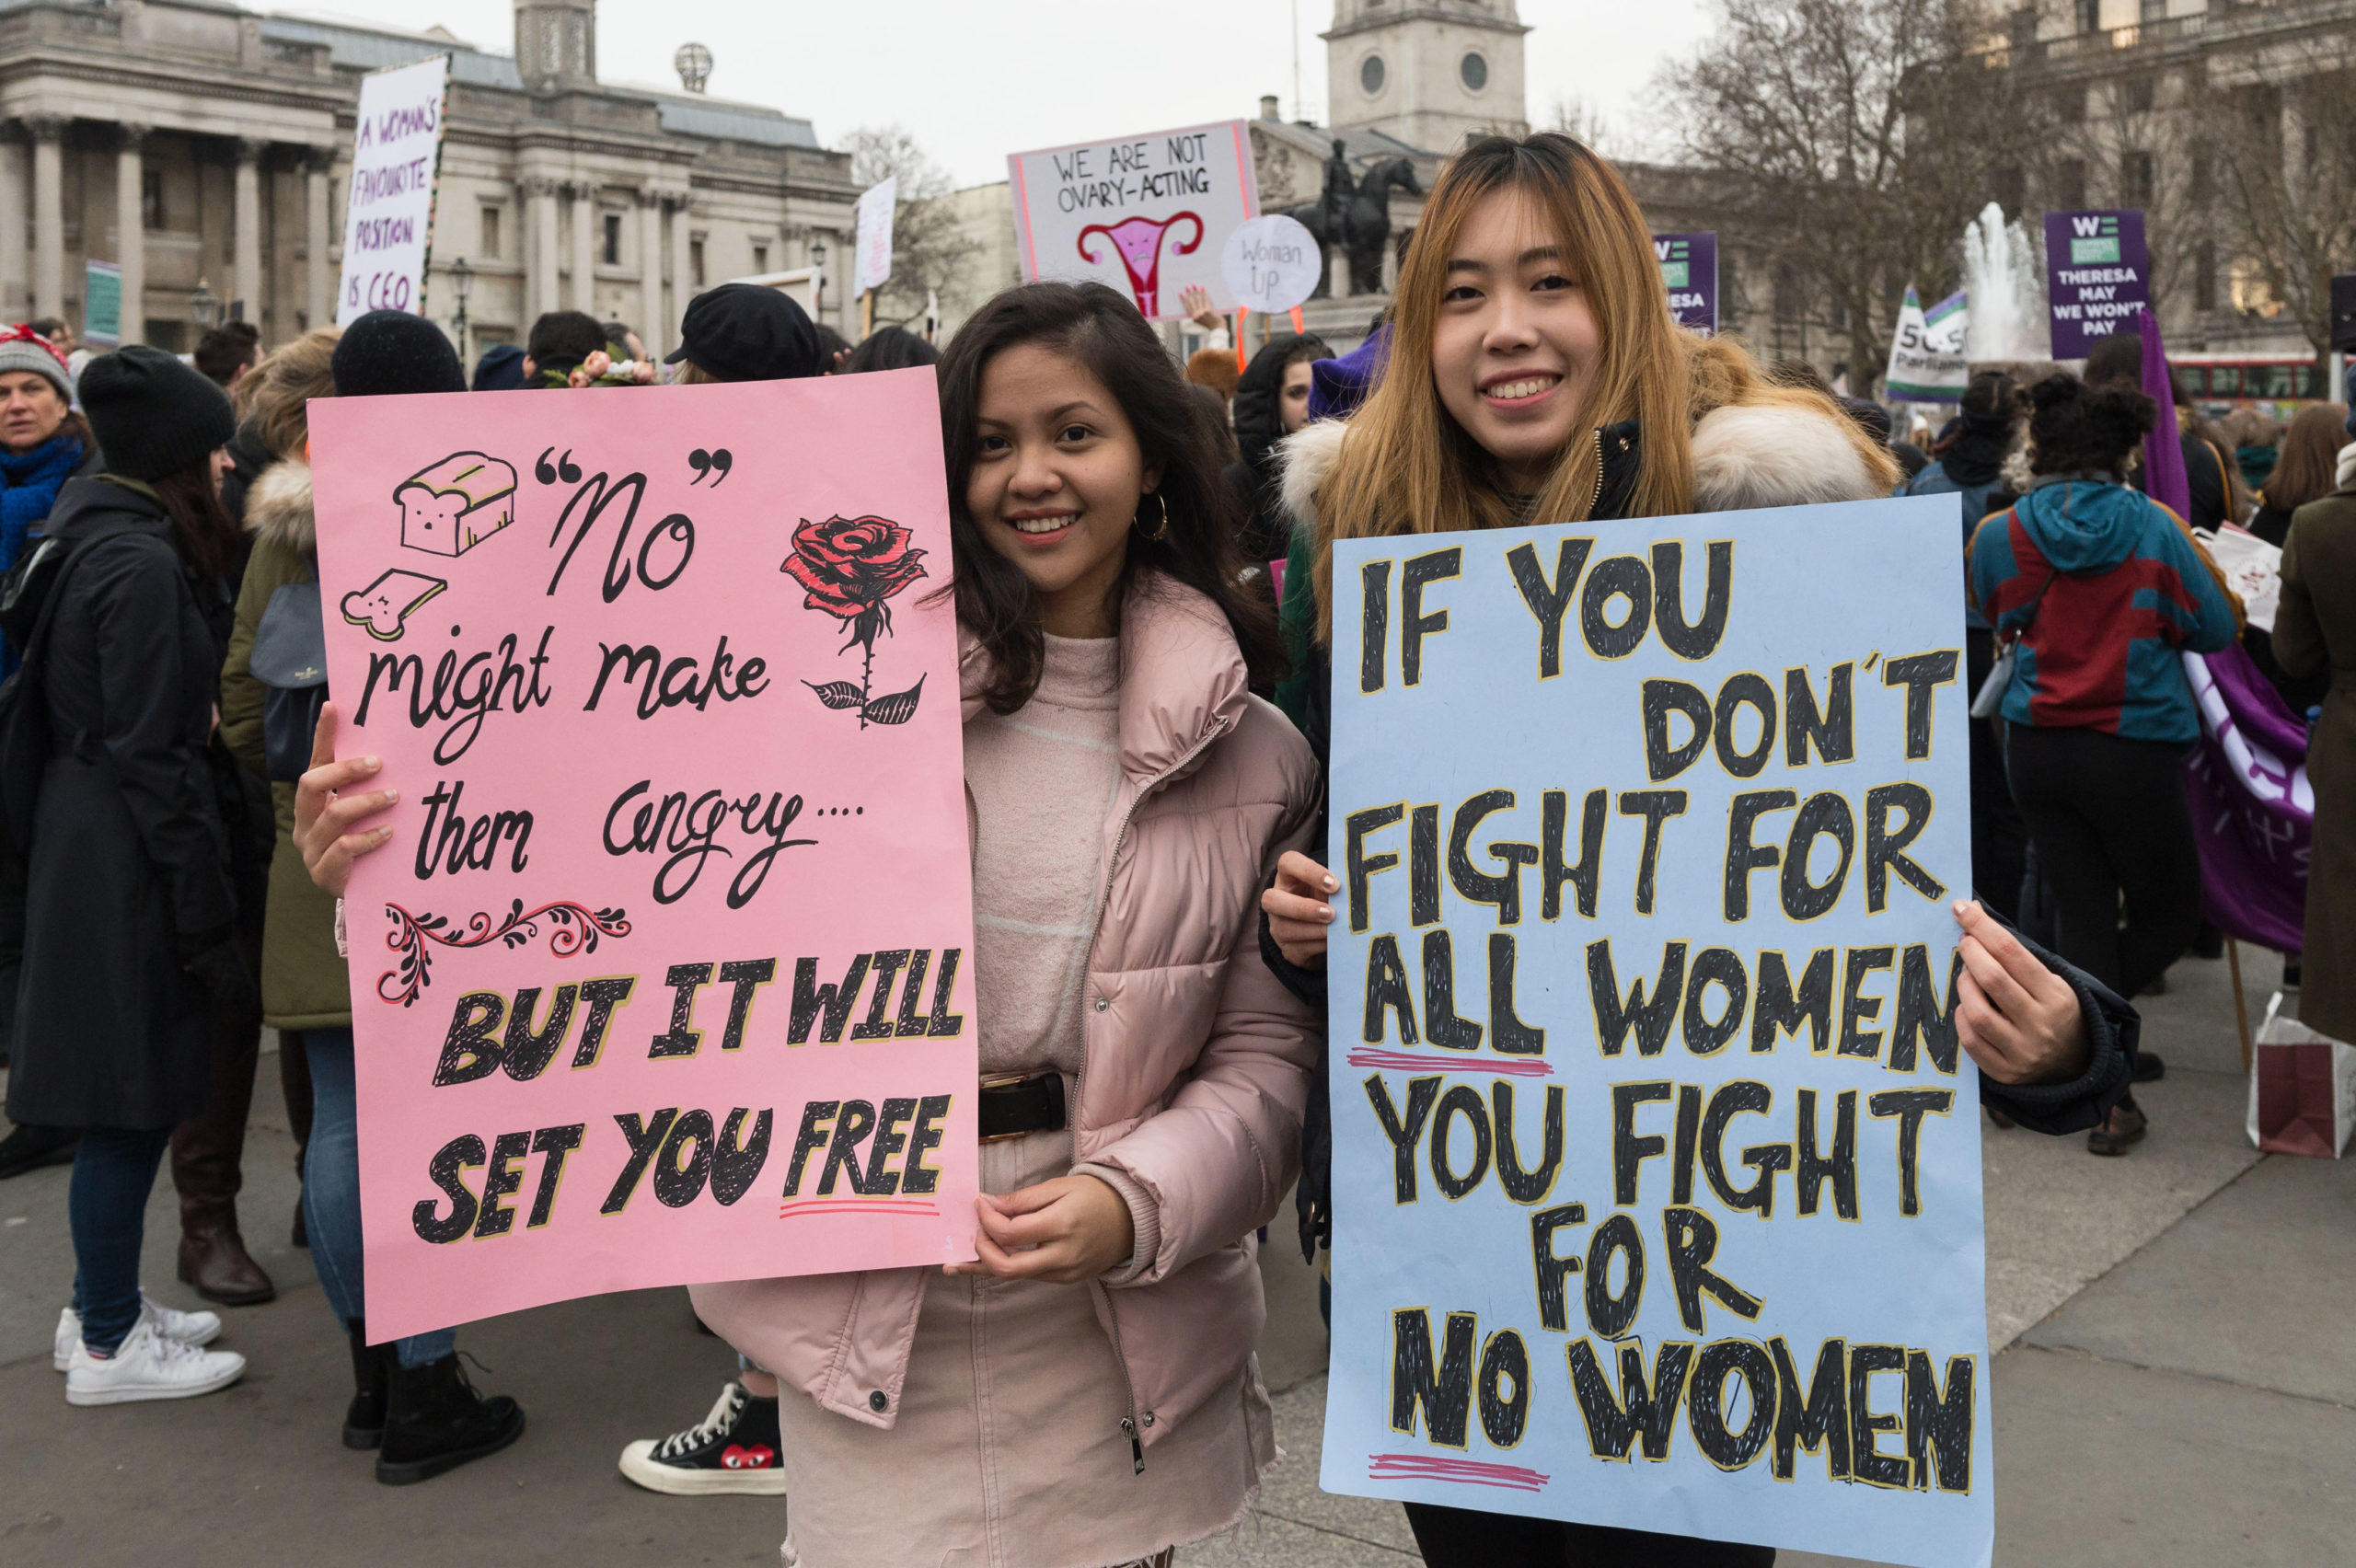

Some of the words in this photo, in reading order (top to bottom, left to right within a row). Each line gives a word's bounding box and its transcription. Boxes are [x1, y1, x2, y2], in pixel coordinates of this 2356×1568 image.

[359, 117, 372, 149] A
[379, 97, 437, 144] WOMAN'S
[1053, 148, 1093, 181] WE
[1109, 142, 1149, 174] ARE
[1168, 133, 1207, 165] NOT
[353, 156, 427, 206] FAVOURITE
[1057, 167, 1210, 213] OVARY-ACTING
[354, 216, 414, 254] POSITION
[2057, 267, 2138, 285] THERESA
[348, 275, 360, 307] IS
[2052, 305, 2083, 319] WE
[2085, 300, 2146, 318] WON'T
[2078, 285, 2117, 301] MAY
[2082, 320, 2117, 336] PAY
[1359, 545, 1464, 696] IF
[1505, 536, 1737, 682] YOU
[353, 625, 555, 766] might
[1640, 648, 1962, 783] DON'T
[414, 779, 534, 881] them
[1345, 787, 1691, 935] FIGHT
[1723, 780, 1948, 924] FOR
[433, 974, 640, 1088] BUT
[648, 957, 780, 1060] IT
[787, 948, 964, 1046] WILL
[1362, 928, 1546, 1055] ALL
[1584, 935, 1961, 1076] WOMEN
[411, 1123, 587, 1245] SET
[599, 1107, 774, 1217] YOU
[782, 1094, 954, 1200] FREE
[1362, 1073, 1566, 1206] YOU
[1610, 1078, 1957, 1223] FIGHT
[1530, 1201, 1766, 1341] FOR
[1388, 1306, 1531, 1451] NO
[1564, 1334, 1977, 1495] WOMEN
